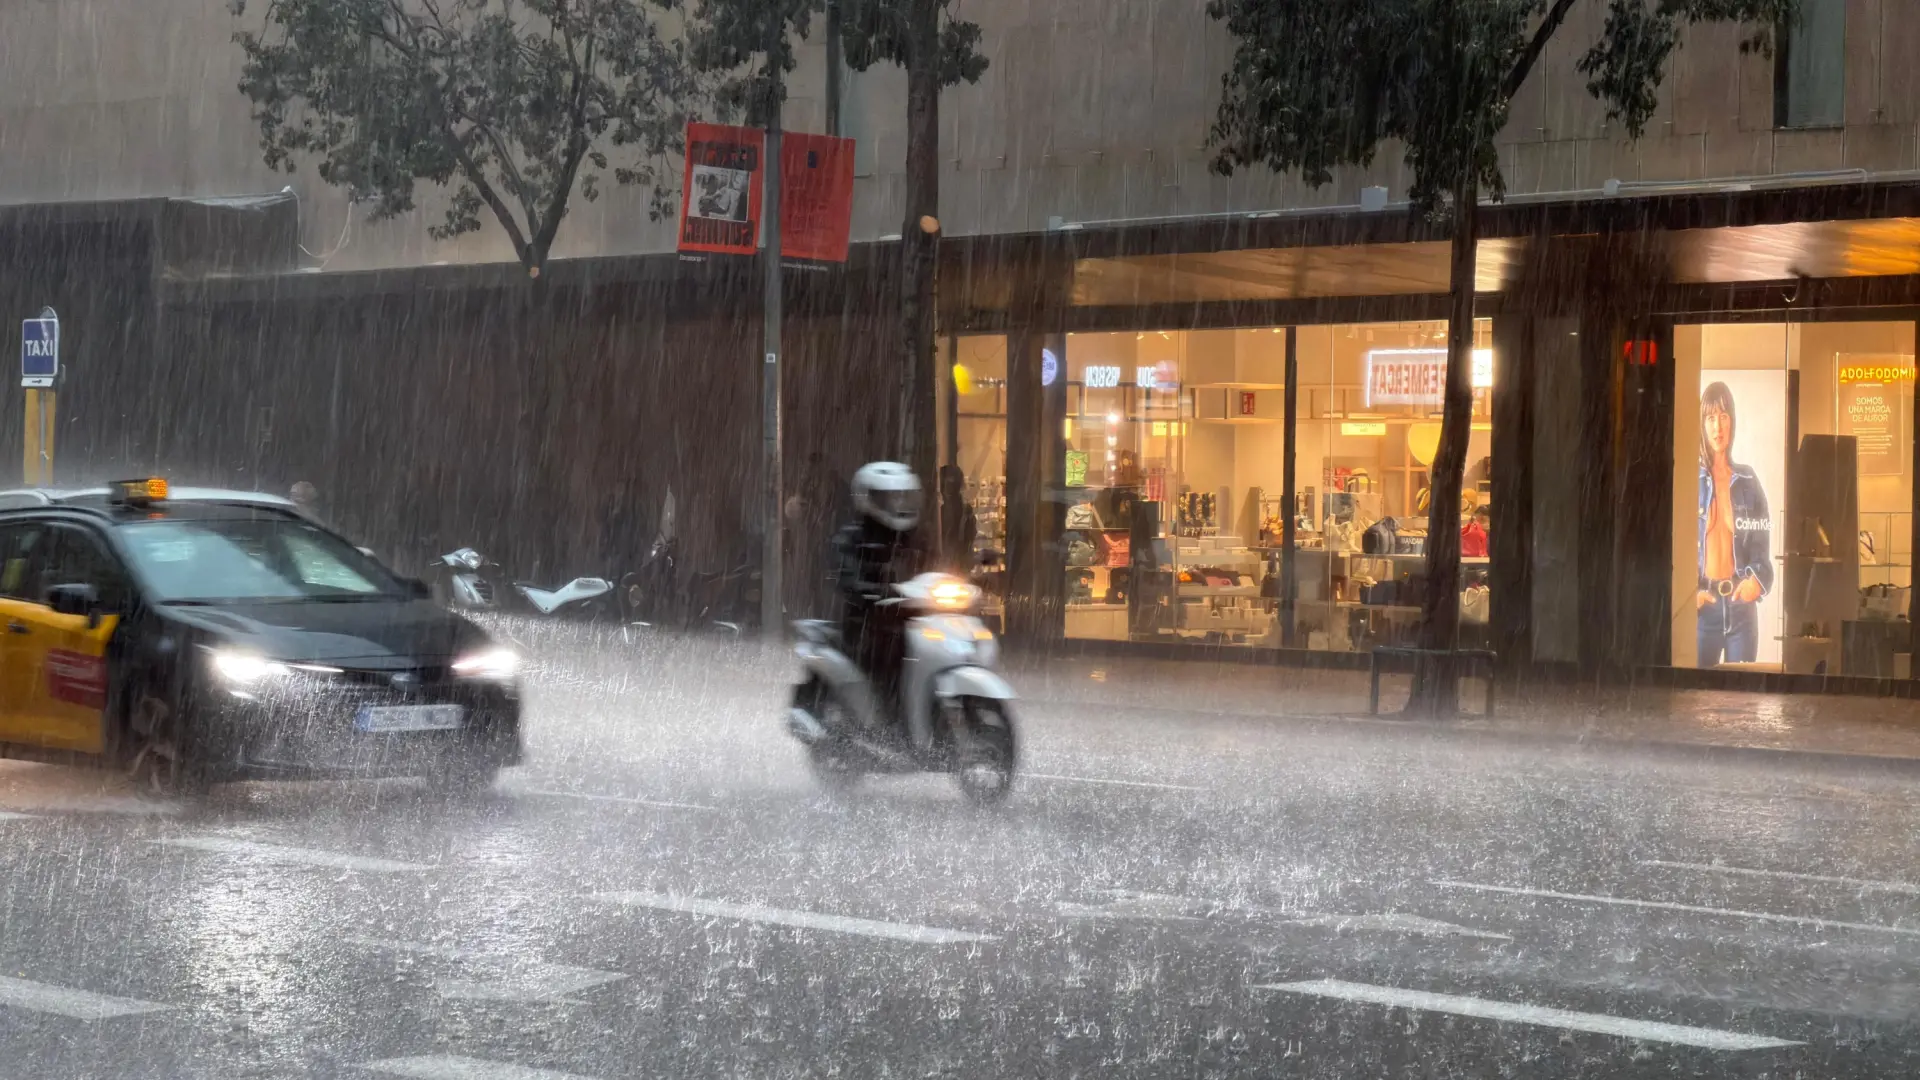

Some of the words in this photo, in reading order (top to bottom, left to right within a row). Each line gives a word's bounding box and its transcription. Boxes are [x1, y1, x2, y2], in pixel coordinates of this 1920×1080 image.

[25, 340, 53, 356] TAXI
[1856, 397, 1883, 405] SOMOS
[1848, 405, 1863, 413] UNA
[1735, 517, 1760, 530] Calvin
